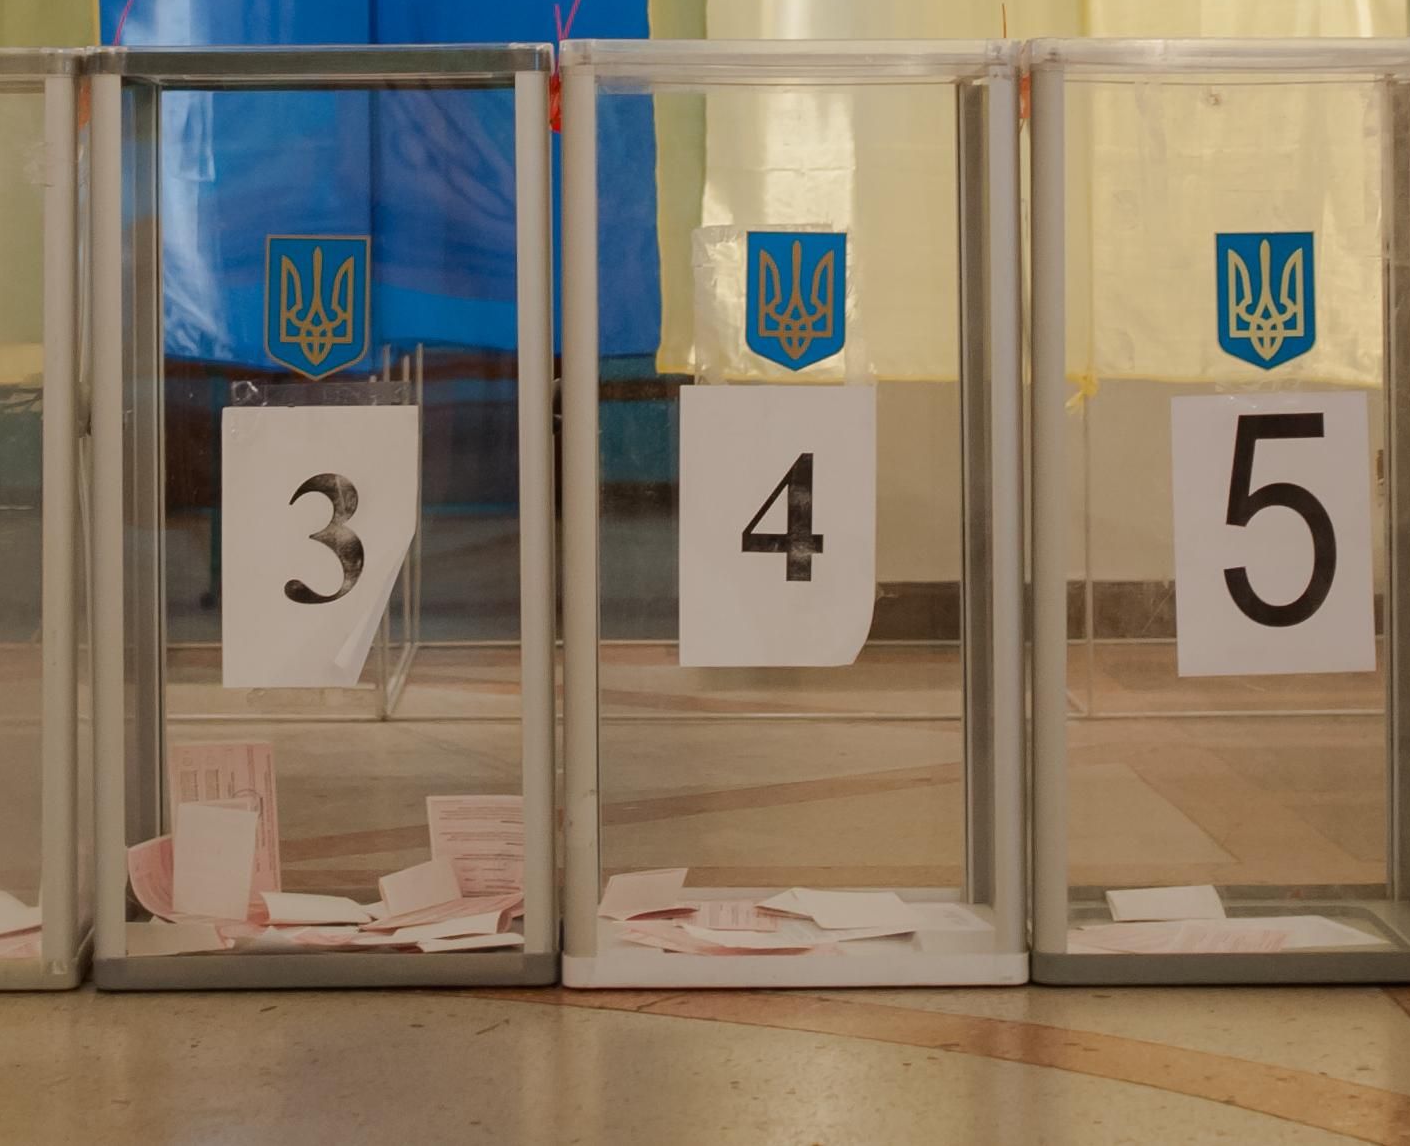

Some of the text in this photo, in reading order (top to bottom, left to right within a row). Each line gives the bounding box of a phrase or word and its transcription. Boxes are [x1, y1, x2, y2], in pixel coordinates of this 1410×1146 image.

[283, 472, 365, 605] 3
[741, 452, 824, 582] 4
[1223, 412, 1337, 628] 5
